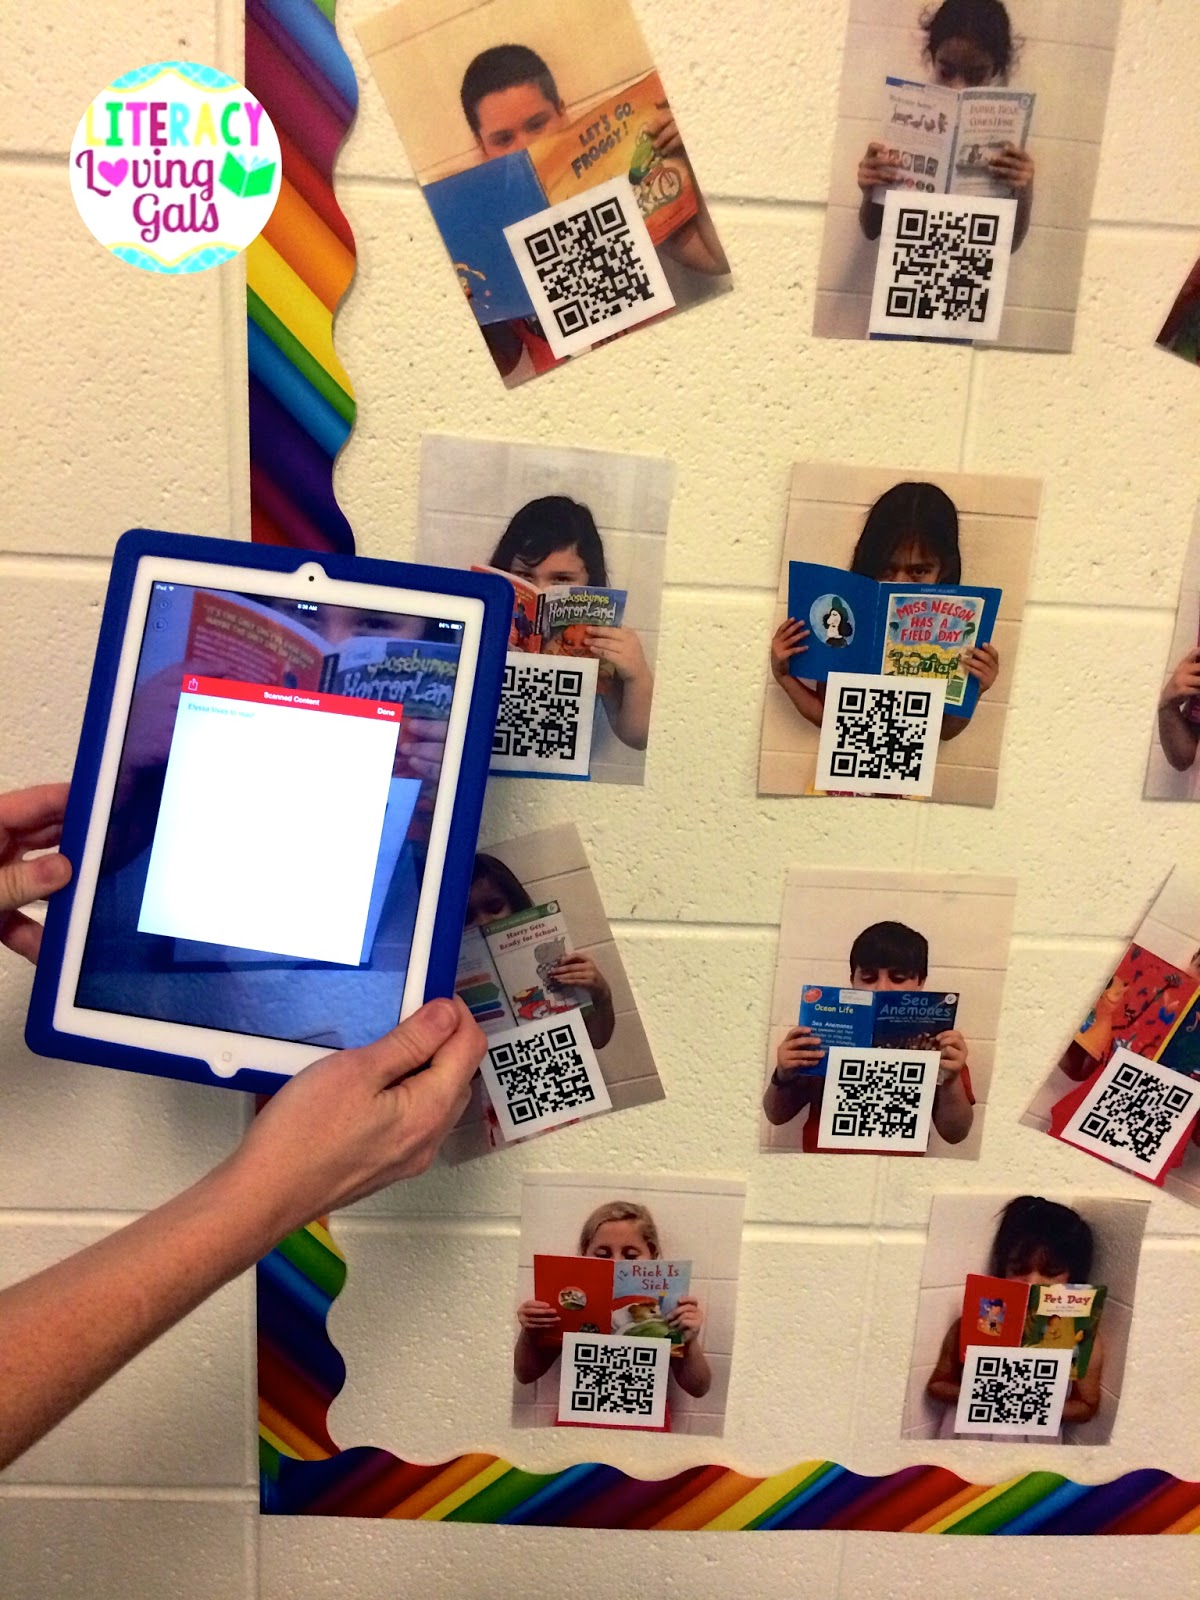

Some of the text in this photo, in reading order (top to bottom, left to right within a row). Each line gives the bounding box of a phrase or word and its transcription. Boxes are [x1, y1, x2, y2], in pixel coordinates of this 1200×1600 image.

[578, 113, 611, 147] LET'S
[548, 601, 616, 622] HorrorLand
[896, 600, 975, 622] MISS NELSON
[910, 617, 949, 629] HAS A
[901, 629, 963, 643] FIELD DAY
[263, 691, 320, 706] Scanned Content
[376, 707, 396, 717] Done
[506, 922, 545, 940] Harry Gets
[499, 939, 520, 951] Ready
[534, 926, 558, 938] School
[900, 993, 929, 1006] Sea
[814, 1003, 854, 1014] Ocean Life
[880, 1003, 952, 1017] Anemones
[632, 1264, 679, 1277] Rick Is
[641, 1278, 669, 1290] Sick
[1043, 1294, 1091, 1306] Pet Day
